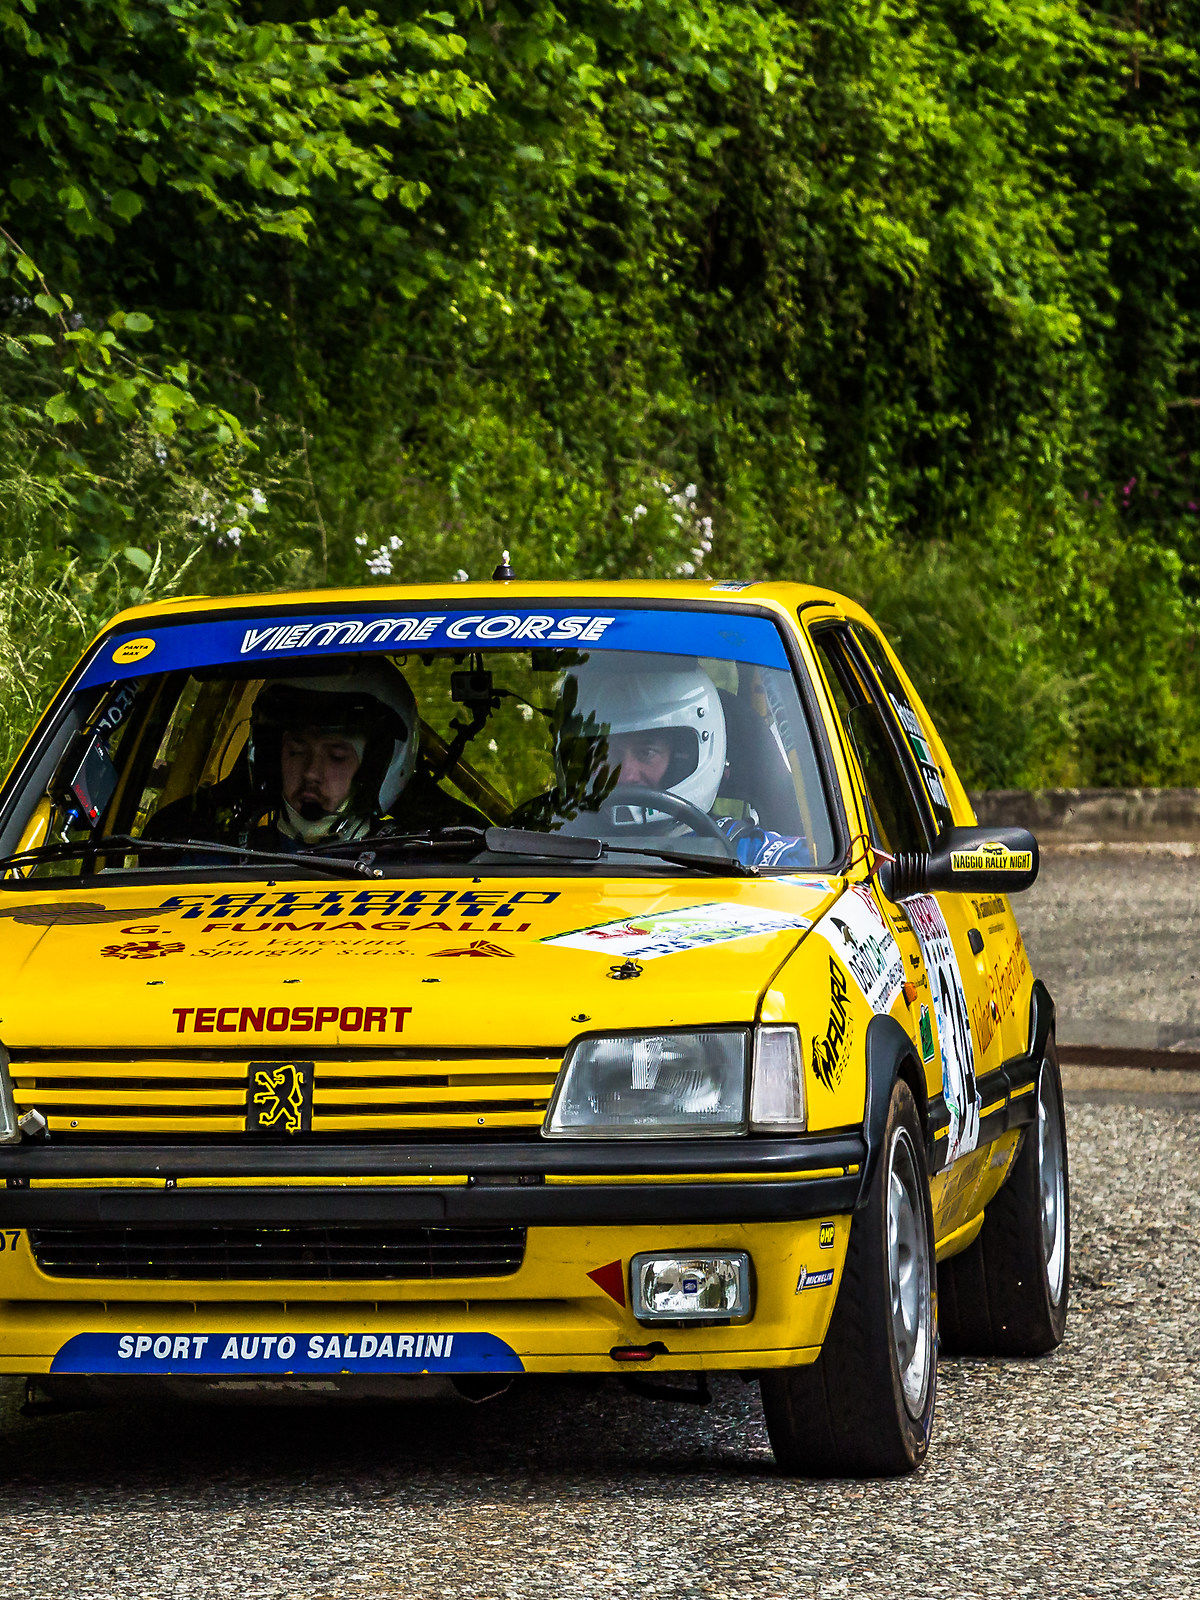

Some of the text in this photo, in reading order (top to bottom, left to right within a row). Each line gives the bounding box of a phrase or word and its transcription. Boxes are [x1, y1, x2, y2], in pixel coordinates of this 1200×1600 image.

[240, 615, 616, 653] VIEMME CORSE
[985, 855, 1008, 869] RALLY
[1009, 853, 1031, 869] NIGHT
[158, 890, 563, 908] CATTANEO
[180, 902, 516, 919] IMPIANTI
[119, 921, 532, 935] G. FUMAGALLI
[215, 938, 407, 947] la Varesina
[189, 947, 323, 959] Spurghi
[172, 1006, 413, 1033] TECNOSPORT
[820, 1226, 835, 1244] OMP
[805, 1271, 834, 1285] MICHELIN
[117, 1334, 454, 1360] SPORT AUTO SALDARINI
